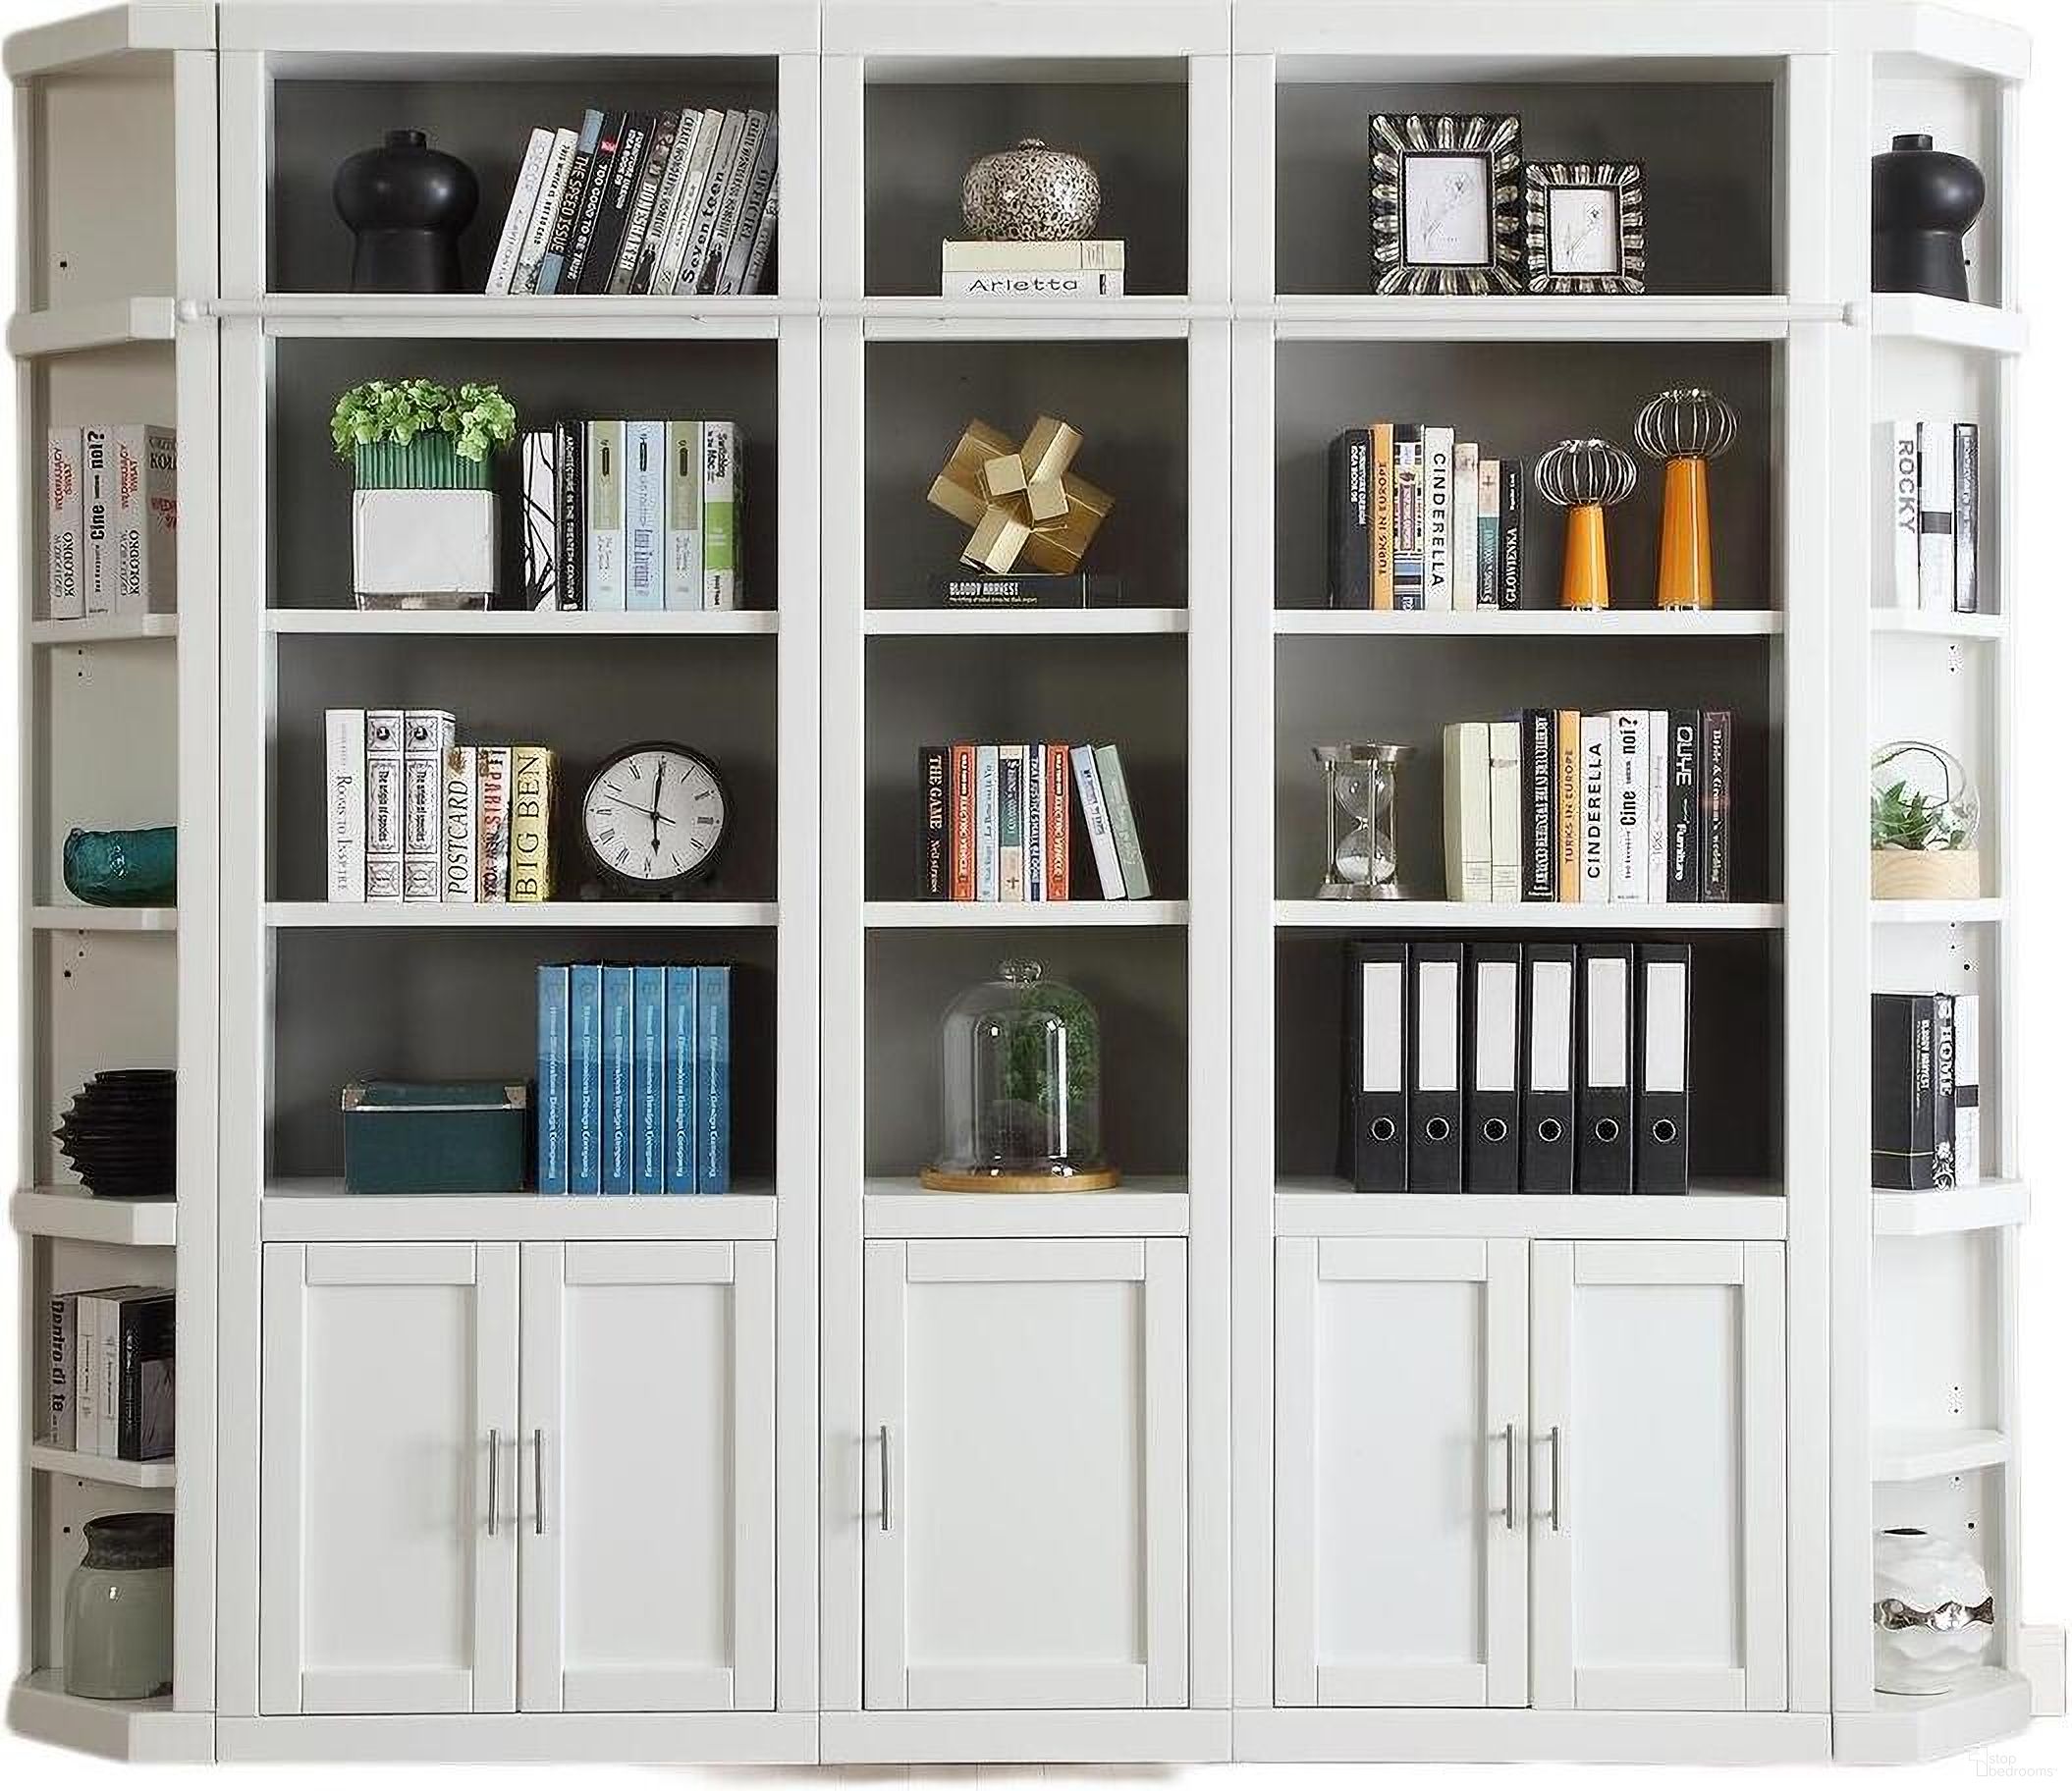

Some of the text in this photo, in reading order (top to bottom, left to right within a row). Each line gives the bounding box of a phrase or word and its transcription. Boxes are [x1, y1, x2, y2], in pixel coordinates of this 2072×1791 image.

[593, 162, 606, 185] TOO
[550, 155, 588, 252] THE SPEED ISSUE
[585, 186, 600, 218] GOOD
[580, 219, 591, 234] TO
[619, 181, 657, 271] BONESHAKER
[969, 278, 1078, 292] Arletta
[87, 431, 105, 469] noi?
[1899, 440, 1915, 533] ROCKY
[90, 504, 105, 540] Cine
[1379, 516, 1387, 530] IN
[1432, 453, 1446, 587] CINDERELLA
[950, 582, 981, 596] BLOODY
[1620, 716, 1637, 755] noi?
[929, 755, 942, 786] THE
[484, 771, 500, 825] PARIS
[929, 787, 943, 830] GAME
[1565, 749, 1574, 863] TURKS IN EUROPE
[1587, 743, 1601, 878] CINDERELLA
[1621, 790, 1636, 826] Cine
[448, 780, 468, 894] POSTCARD
[516, 753, 540, 897] BIG BEN
[1675, 823, 1687, 881] Furniture
[52, 1300, 66, 1362] Dentro
[53, 1369, 66, 1385] di
[52, 1393, 65, 1411] te
